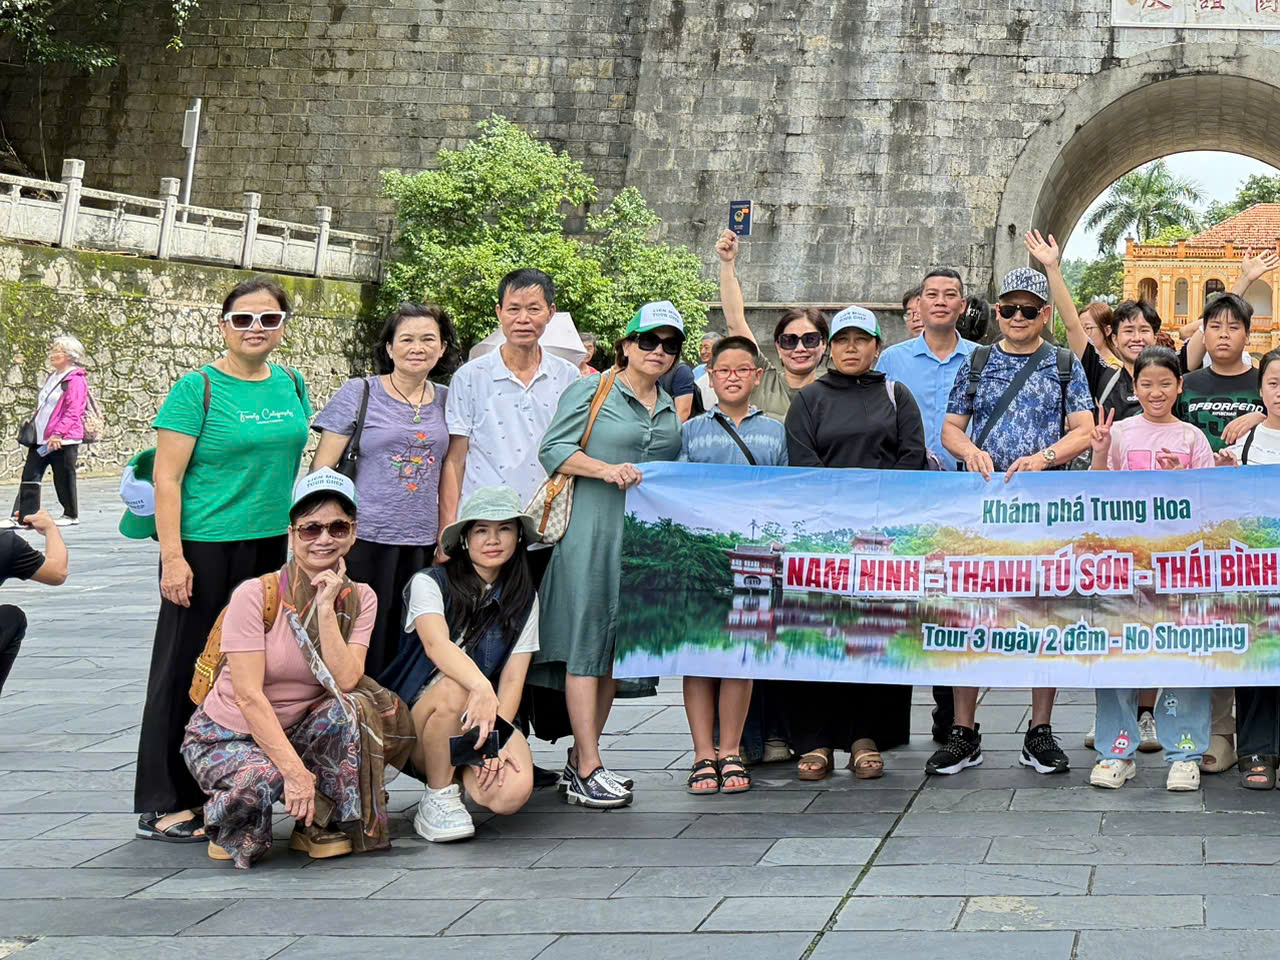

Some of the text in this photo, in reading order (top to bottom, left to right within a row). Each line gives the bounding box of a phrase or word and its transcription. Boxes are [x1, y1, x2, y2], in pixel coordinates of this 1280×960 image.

[983, 495, 1191, 526] Khám phá Trung Hoa
[787, 557, 850, 591] NAM
[859, 559, 921, 592] NINH
[949, 559, 1032, 592] THANH
[1040, 550, 1072, 591] TÚ
[1079, 554, 1130, 591] SƠN
[1156, 546, 1212, 589] THÁI
[1220, 545, 1278, 587] BÌNH
[925, 625, 968, 647] Tour
[973, 628, 986, 649] 3
[991, 625, 1040, 653] ngày
[1046, 628, 1058, 651] 2
[1063, 624, 1106, 651] đêm
[1126, 628, 1150, 650] No
[1155, 624, 1246, 654] Shopping
